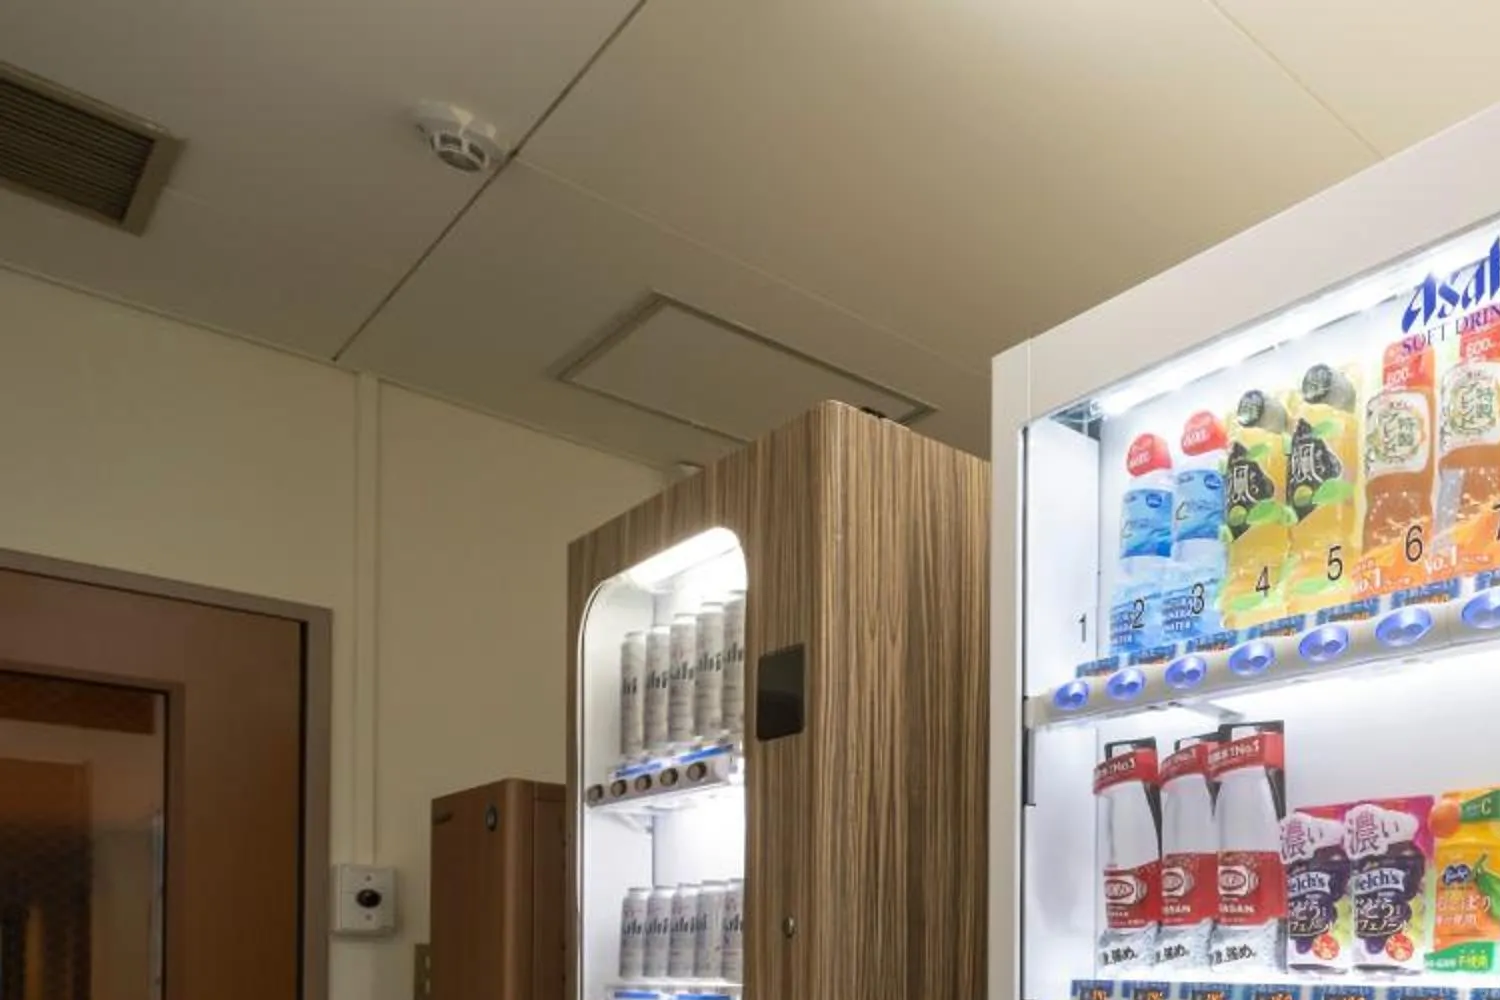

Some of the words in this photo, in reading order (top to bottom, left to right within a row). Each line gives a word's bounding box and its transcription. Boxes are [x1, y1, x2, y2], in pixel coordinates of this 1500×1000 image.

[1402, 323, 1446, 354] SOFT
[1405, 525, 1423, 562] 6
[1327, 546, 1342, 581] 5
[1255, 566, 1270, 597] 4
[1132, 599, 1145, 629] 2
[1191, 583, 1205, 614] 3
[1078, 612, 1087, 643] 1
[1347, 809, 1399, 857] 濃い
